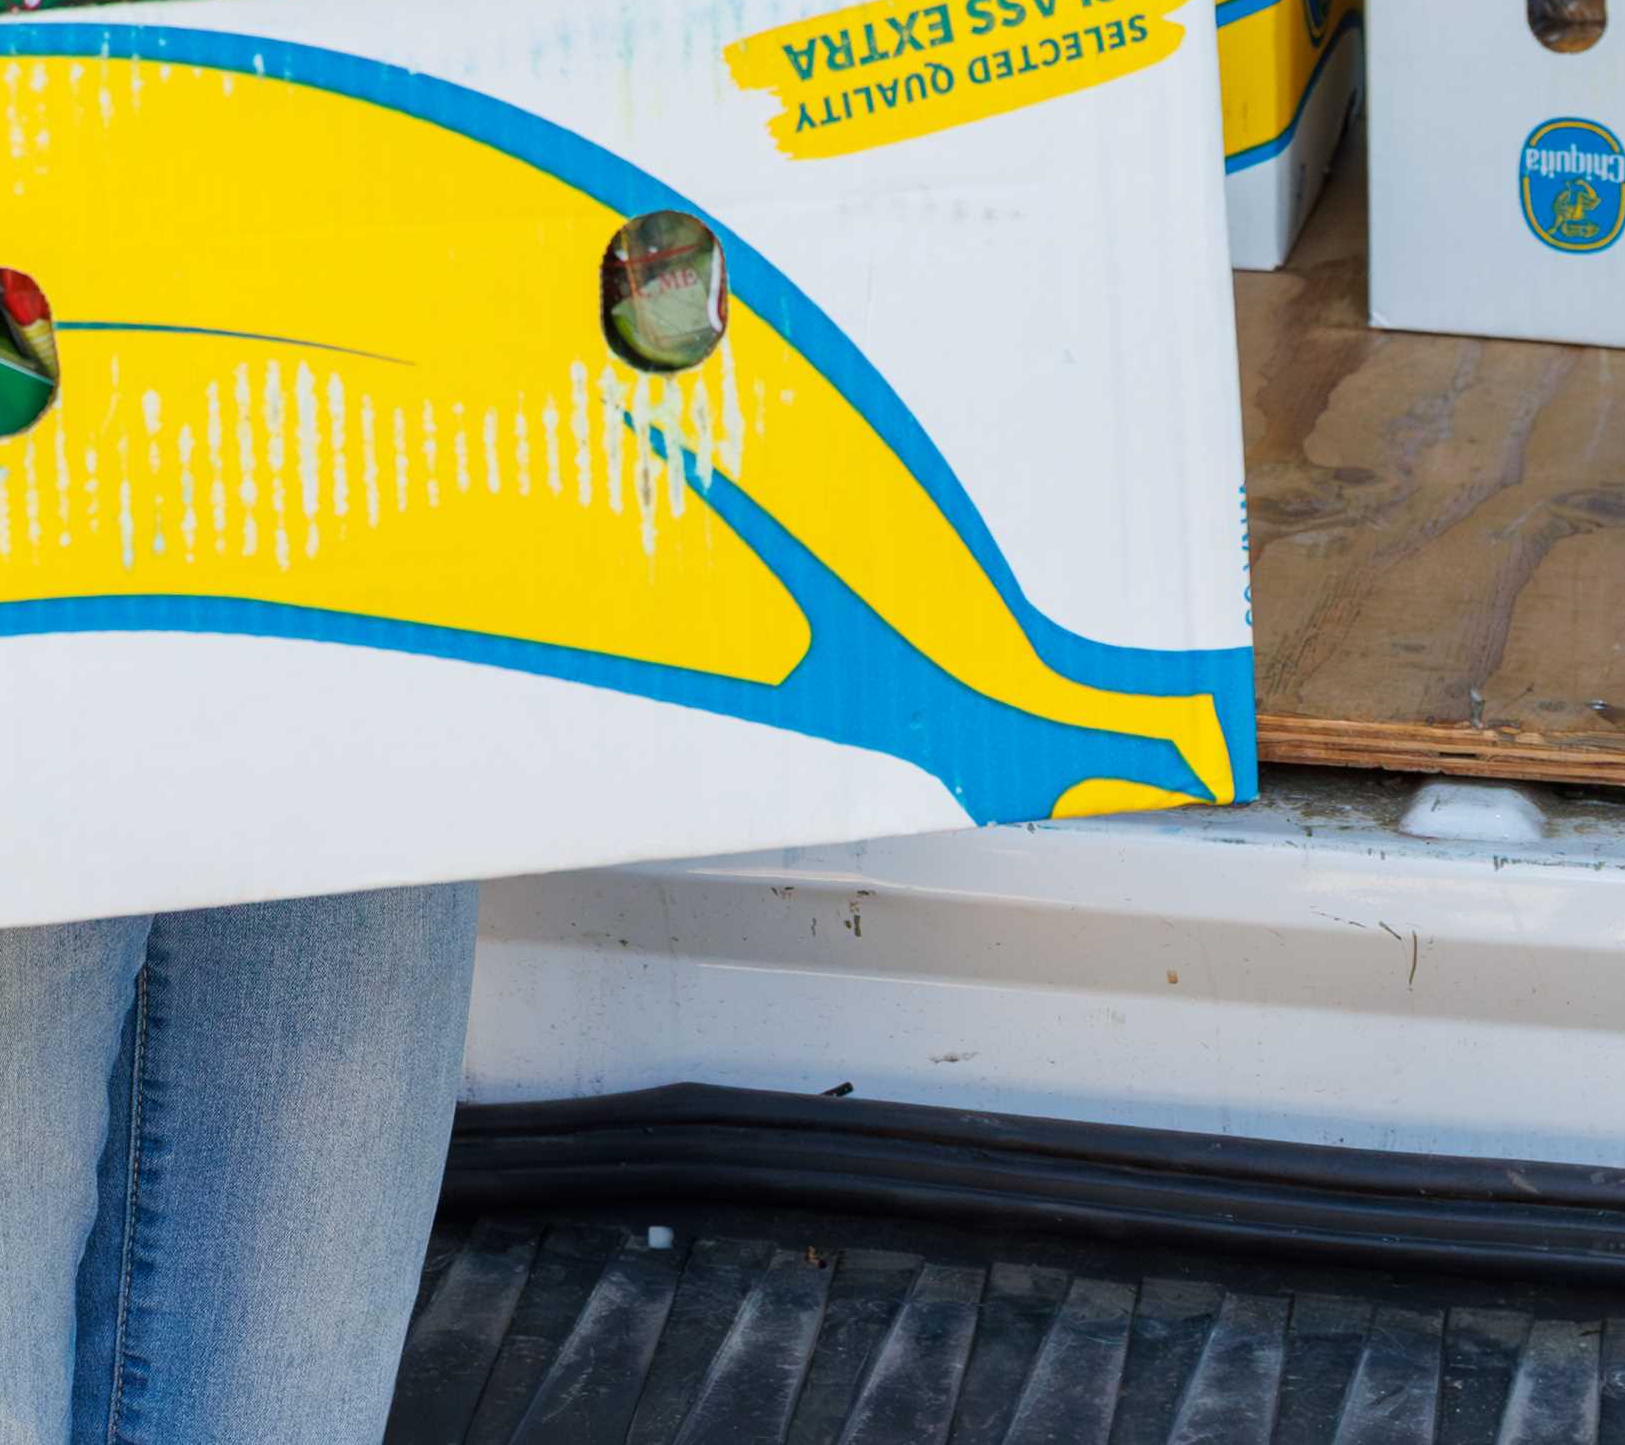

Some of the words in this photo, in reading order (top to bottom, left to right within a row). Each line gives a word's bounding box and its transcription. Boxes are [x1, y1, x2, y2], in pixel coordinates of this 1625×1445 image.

[783, 5, 954, 81] EXTRA
[968, 15, 1147, 84] SELECTED
[795, 64, 955, 132] QUALITY
[1525, 143, 1625, 184] Chiquita
